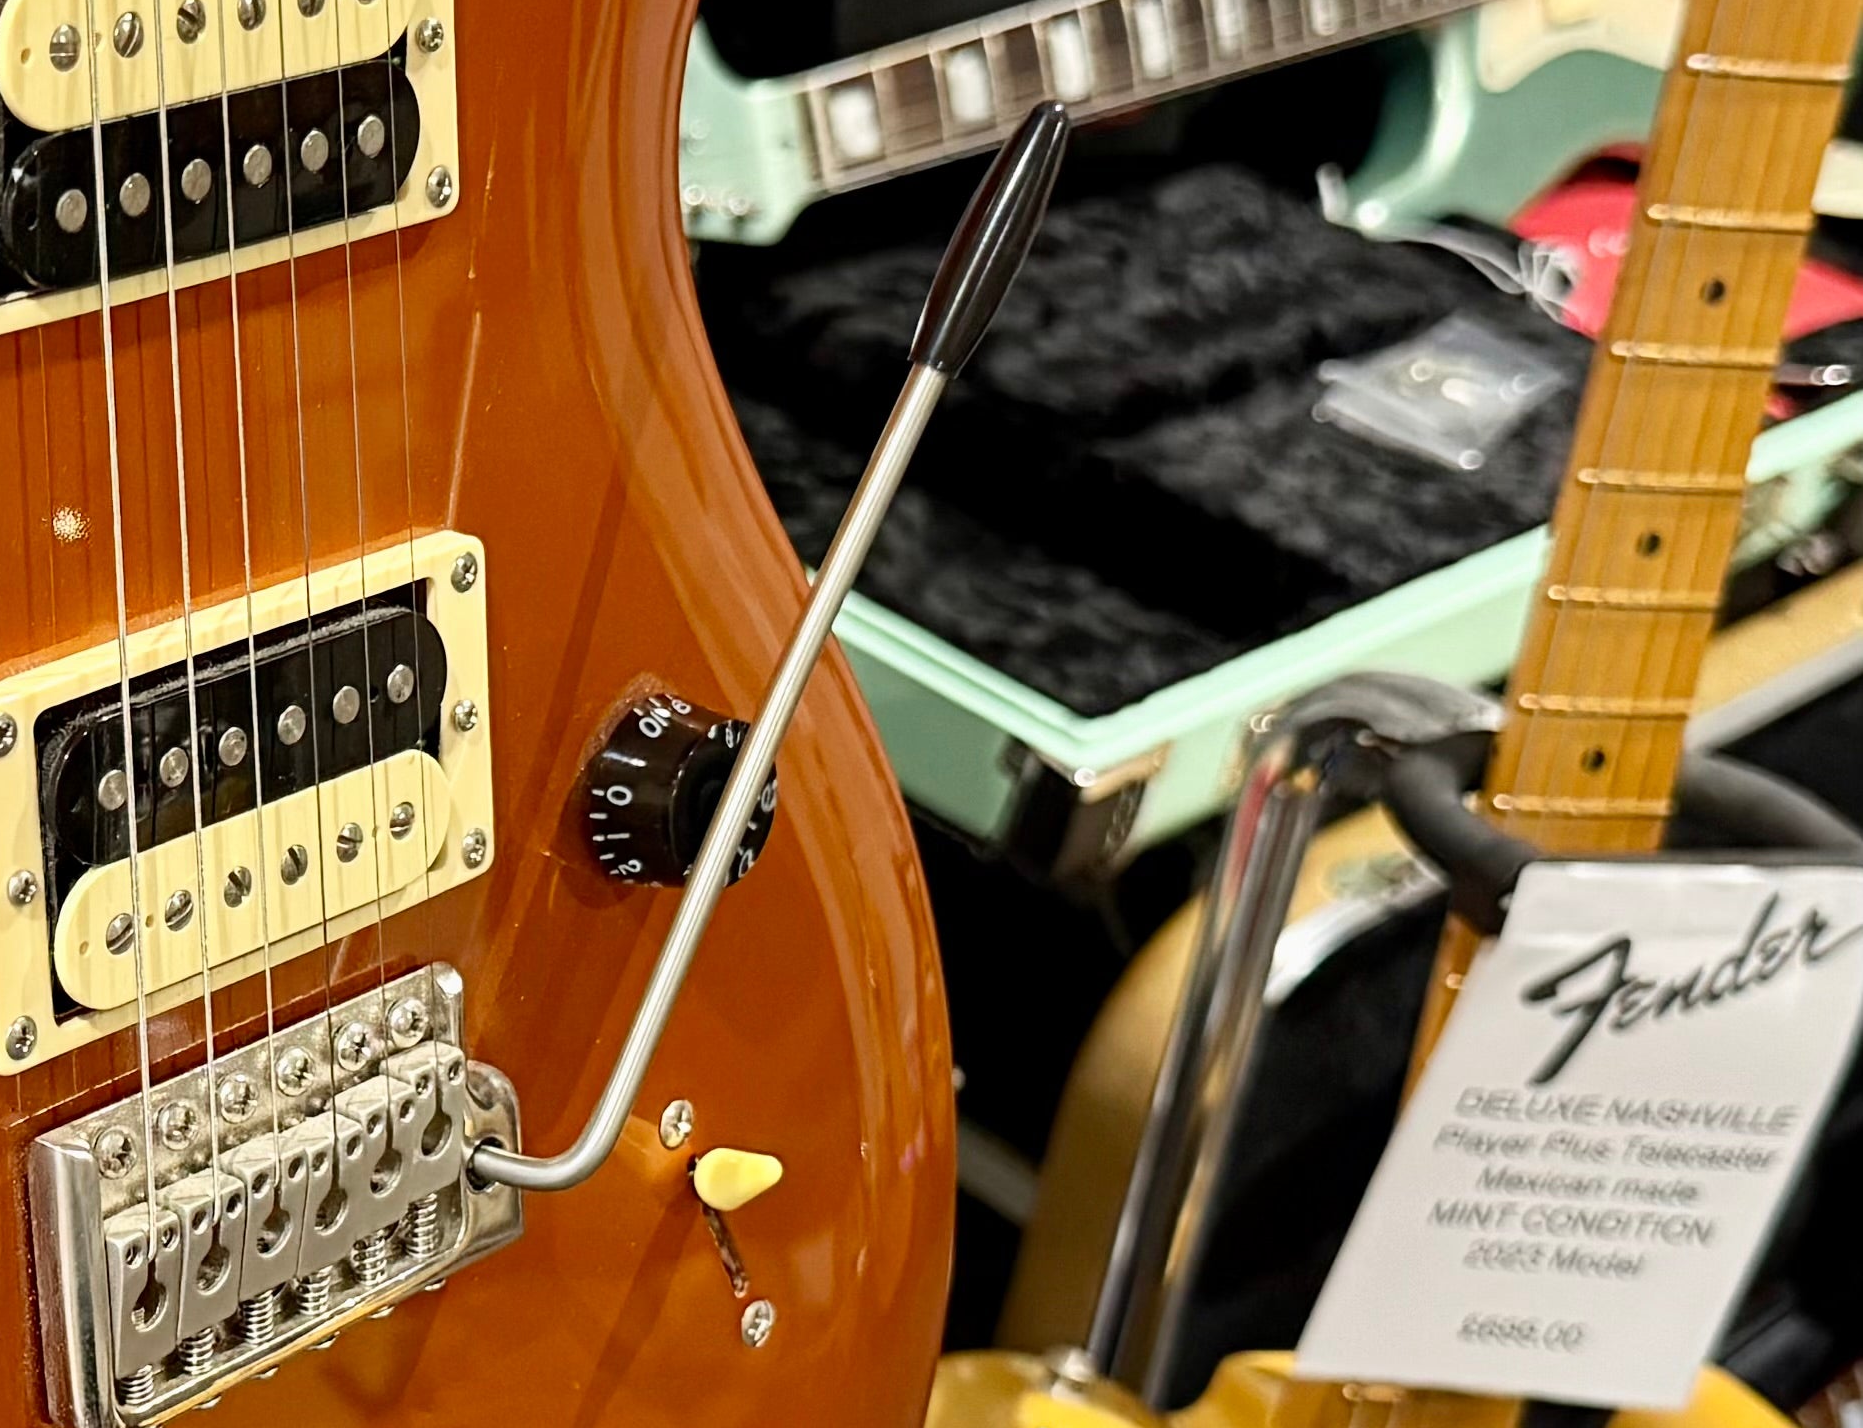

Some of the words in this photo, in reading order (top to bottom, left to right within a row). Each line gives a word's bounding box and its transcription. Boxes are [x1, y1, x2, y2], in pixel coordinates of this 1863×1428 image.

[606, 785, 634, 807] 0
[617, 859, 642, 876] 2
[1519, 890, 1863, 1088] Fender
[1455, 1086, 1602, 1124] DELUXE
[1604, 1097, 1798, 1136] NASHVILLE
[1435, 1123, 1535, 1158] Player
[1539, 1130, 1612, 1164] Plus
[1622, 1134, 1782, 1174] Telecaster
[1476, 1166, 1604, 1199] Mexican
[1609, 1172, 1700, 1204] made
[1428, 1198, 1518, 1232] MINT
[1522, 1207, 1716, 1248] CONDITION
[1548, 1244, 1646, 1280] Model
